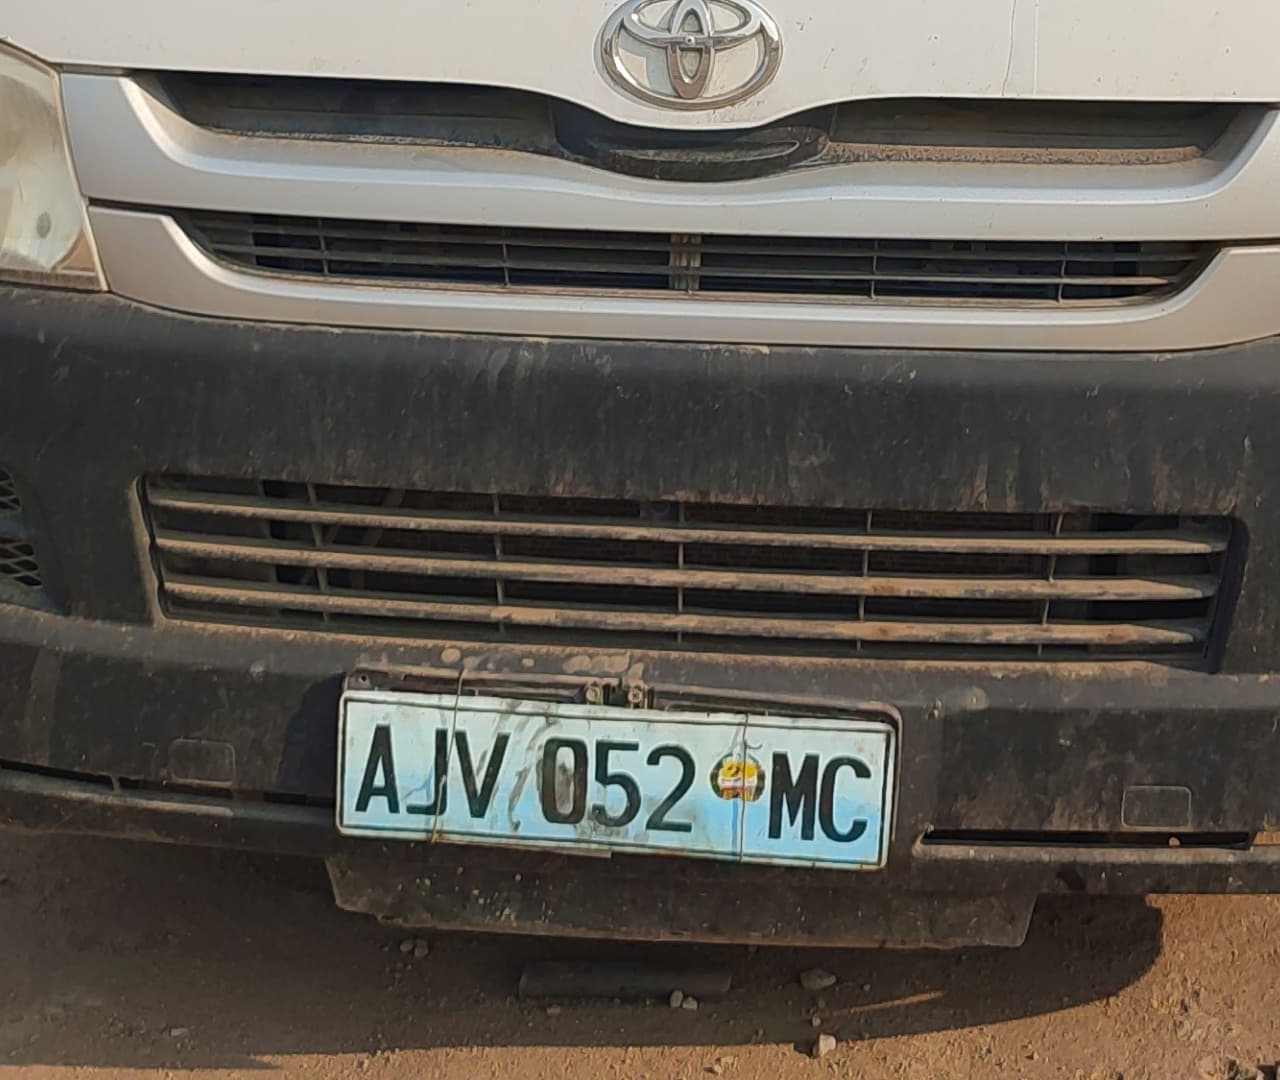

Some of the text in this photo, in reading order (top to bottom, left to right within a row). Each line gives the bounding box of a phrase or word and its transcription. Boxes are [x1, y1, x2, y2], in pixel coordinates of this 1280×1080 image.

[355, 723, 873, 843] AJV 052 MC
